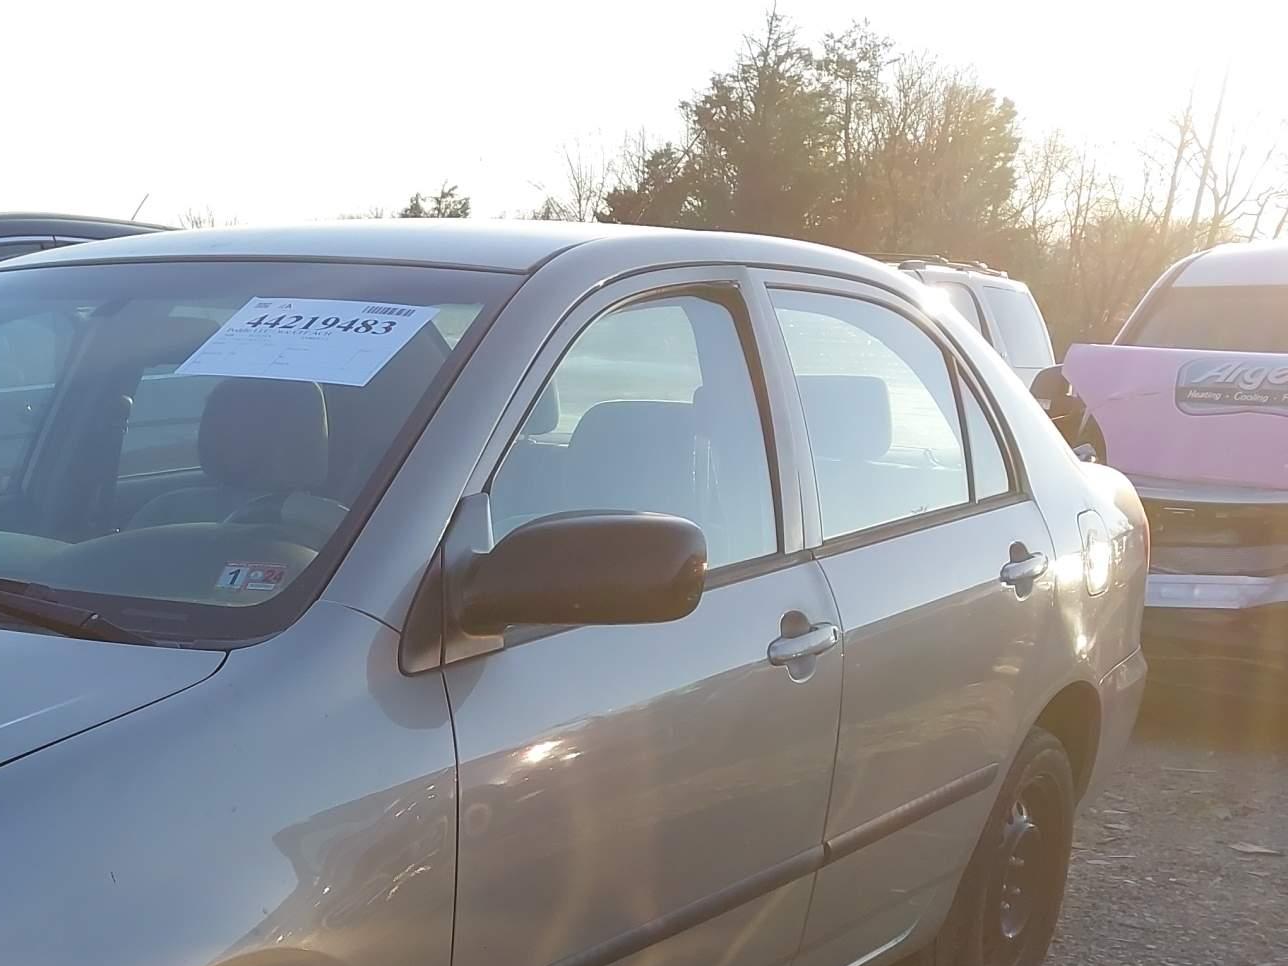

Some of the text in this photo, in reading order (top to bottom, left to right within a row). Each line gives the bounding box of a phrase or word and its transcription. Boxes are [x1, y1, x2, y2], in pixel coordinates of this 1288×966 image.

[247, 314, 397, 335] 44219483
[1187, 389, 1222, 401] Heating
[1234, 391, 1269, 403] Cooling
